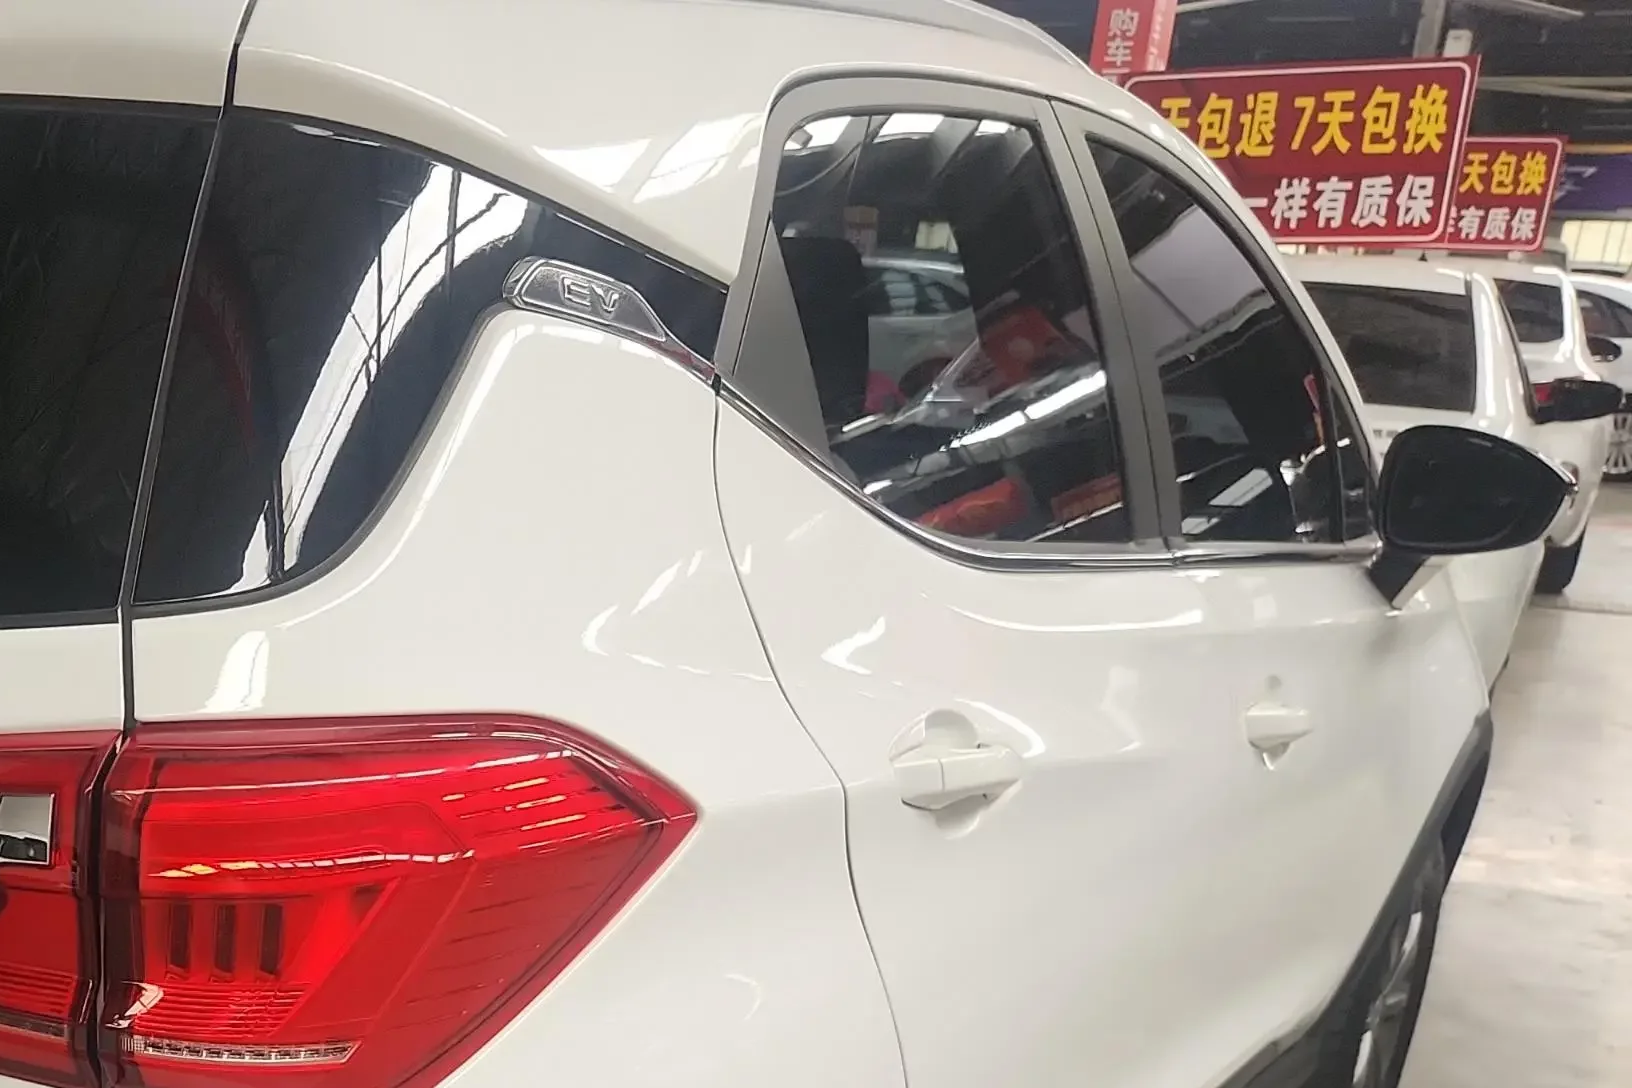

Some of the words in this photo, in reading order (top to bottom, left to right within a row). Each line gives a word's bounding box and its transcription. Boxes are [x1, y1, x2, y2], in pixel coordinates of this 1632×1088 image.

[1289, 83, 1450, 157] 7天包换
[1459, 150, 1549, 197] 天包换
[1448, 206, 1539, 241] 有质保
[562, 275, 621, 317] EV
